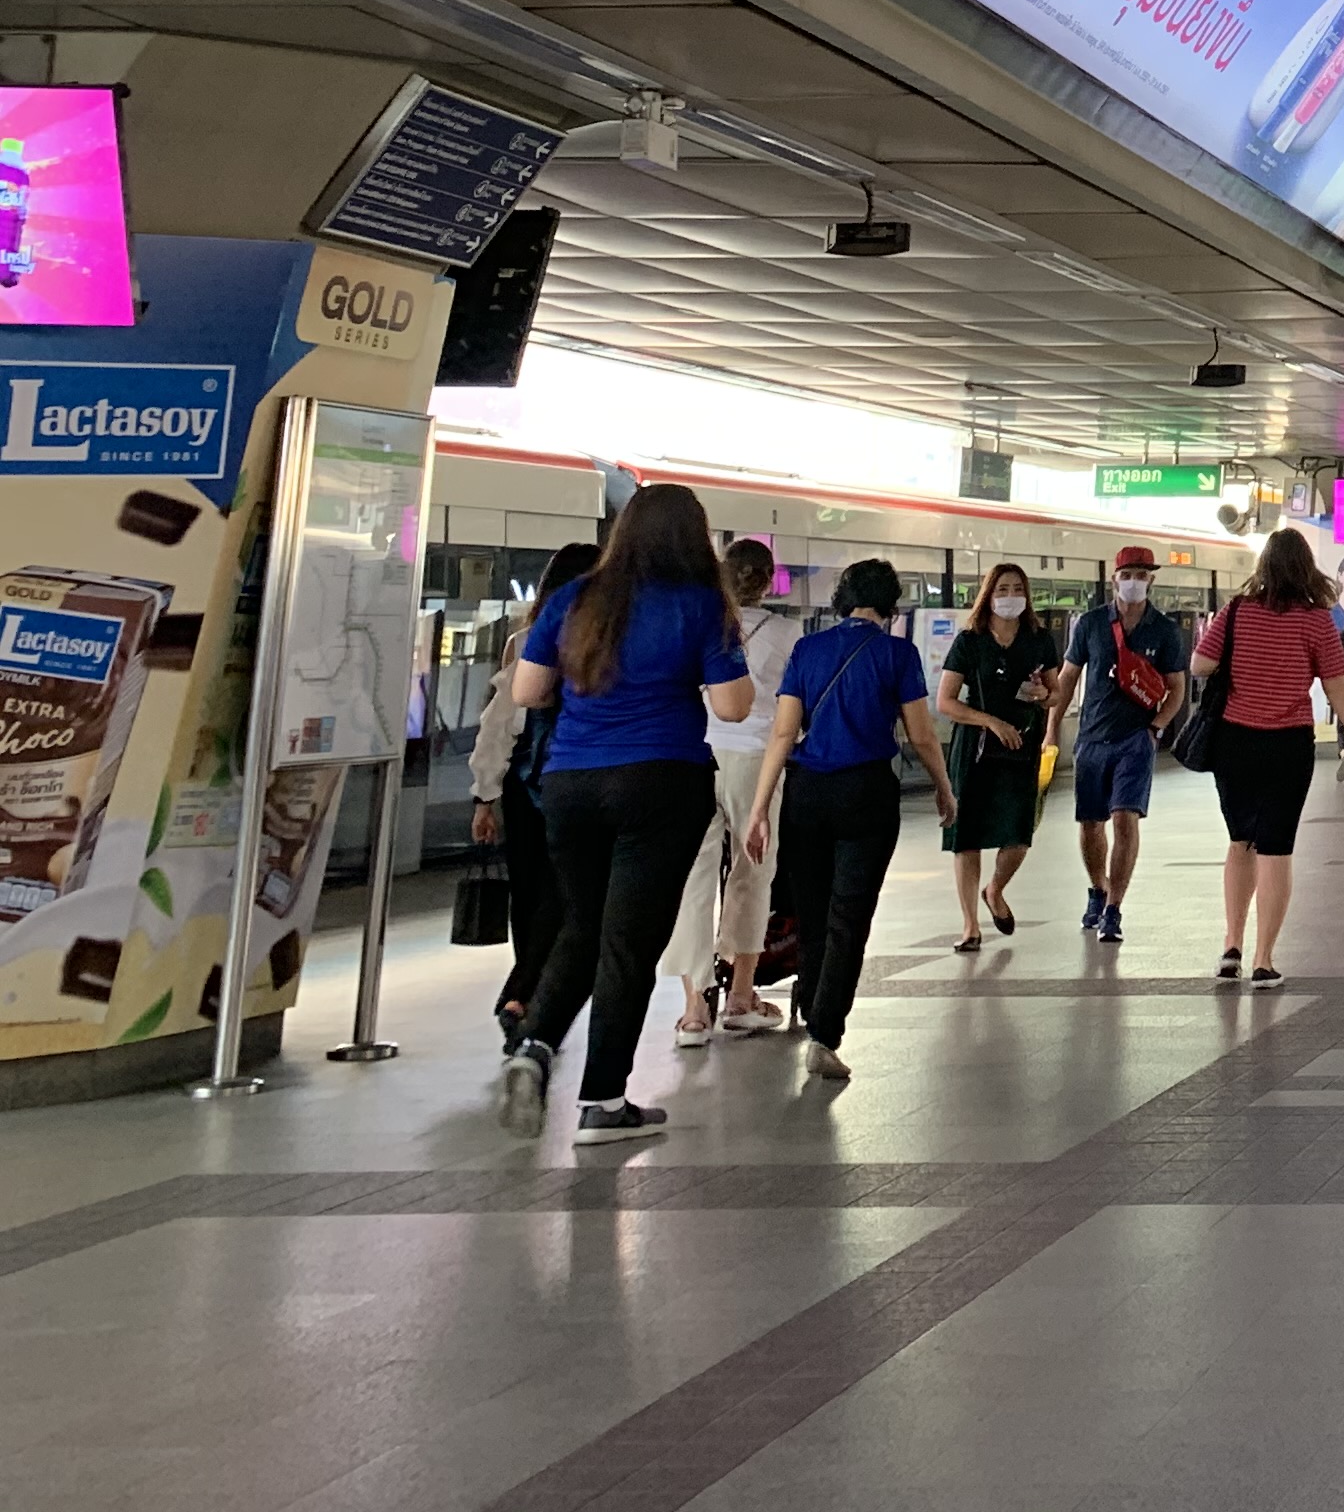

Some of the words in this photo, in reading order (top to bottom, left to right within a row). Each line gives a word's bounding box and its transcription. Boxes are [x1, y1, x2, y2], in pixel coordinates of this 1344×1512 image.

[320, 275, 415, 333] GOLD
[335, 325, 390, 350] SERIES
[2, 377, 218, 463] Lactasoy
[100, 450, 154, 463] SINCE
[161, 450, 201, 463] 1981
[1102, 468, 1163, 483] ทางออก
[1102, 482, 1127, 494] Exit
[6, 585, 53, 602] GOLD
[0, 613, 111, 665] Lactasoy
[0, 671, 42, 687] OYMILK
[3, 697, 66, 721] EXTRA
